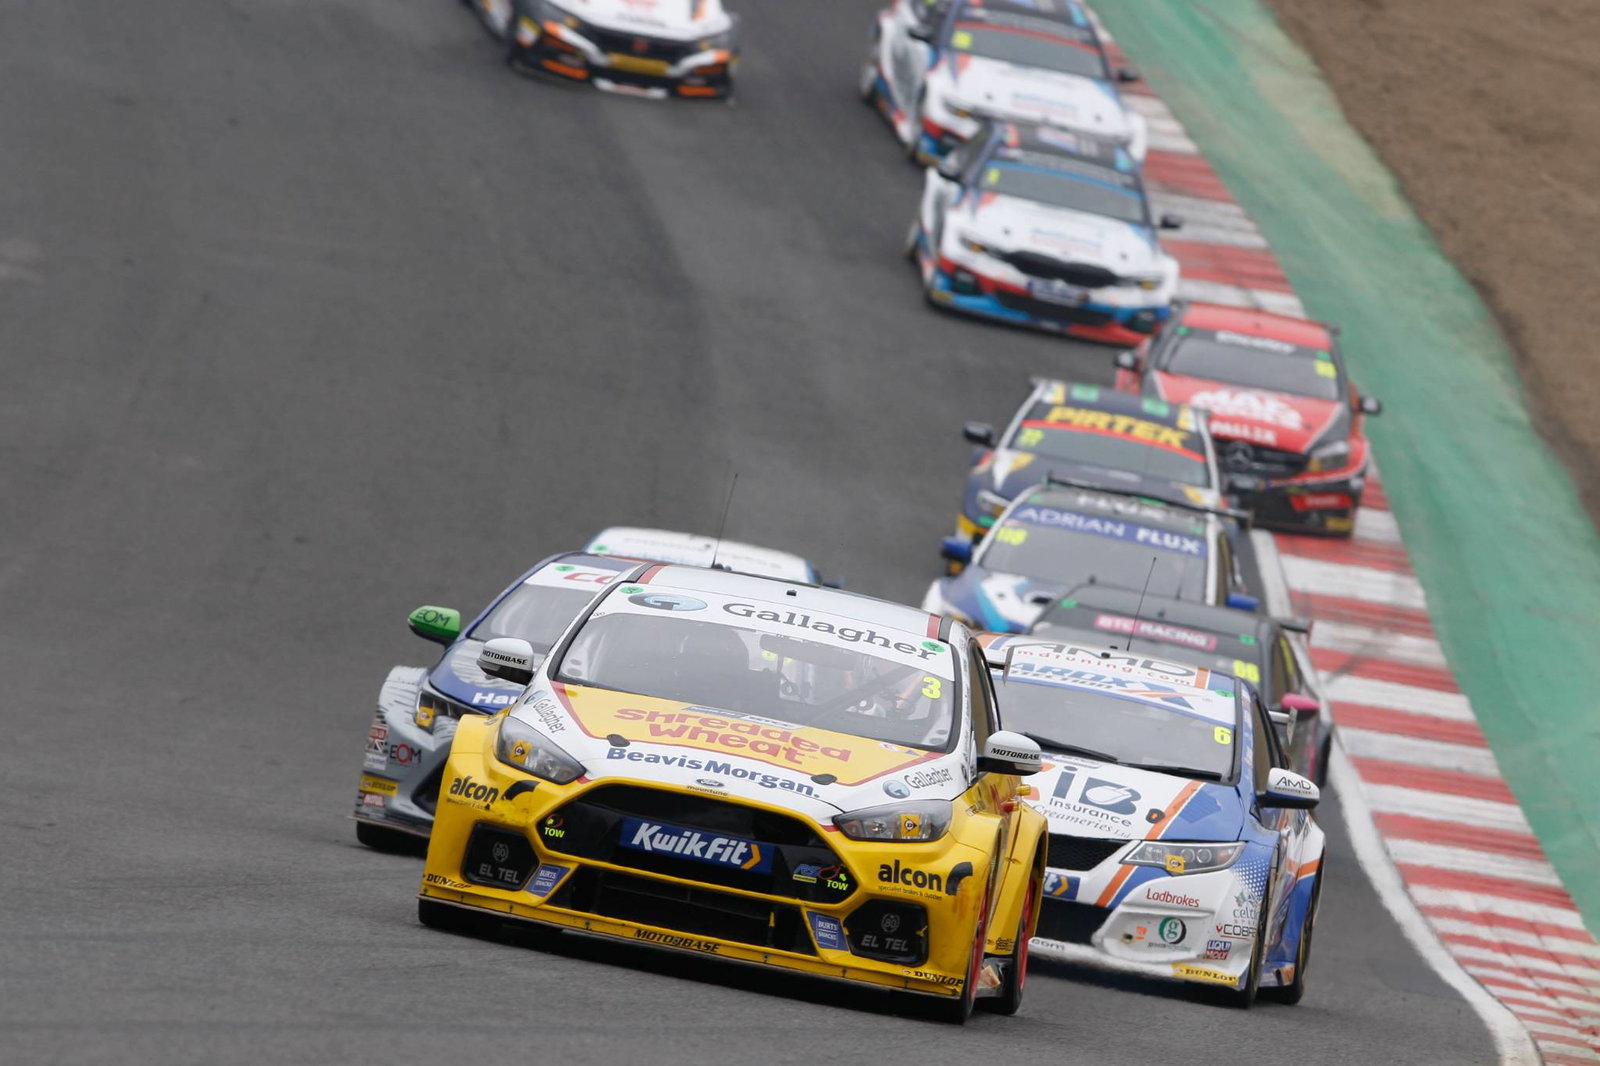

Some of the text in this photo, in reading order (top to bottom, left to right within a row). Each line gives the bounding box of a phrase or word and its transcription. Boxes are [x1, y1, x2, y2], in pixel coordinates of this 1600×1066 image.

[1046, 405, 1190, 449] PIRTEK
[1016, 507, 1200, 553] ADRIAN FLUX
[722, 603, 938, 661] Gallagher
[1138, 622, 1209, 647] RACING
[921, 676, 942, 699] 3
[532, 696, 565, 735] Gallagher
[613, 708, 852, 763] Shredded
[1213, 726, 1232, 745] 6
[389, 743, 422, 763] EOM
[449, 775, 500, 804] alcon
[903, 768, 954, 793] Gallagher
[1276, 776, 1312, 791] AMD
[544, 826, 565, 839] TOW
[426, 873, 473, 890] DUNLOP
[478, 863, 520, 885] EL TEL
[878, 859, 942, 892] alcon
[826, 879, 849, 892] TOW
[1146, 887, 1200, 909] Ladbrokes
[634, 927, 720, 954] MOTORBASE
[861, 934, 910, 953] EL TEL
[914, 971, 964, 987] DUNLOP
[1184, 968, 1238, 984] DUNLOP
